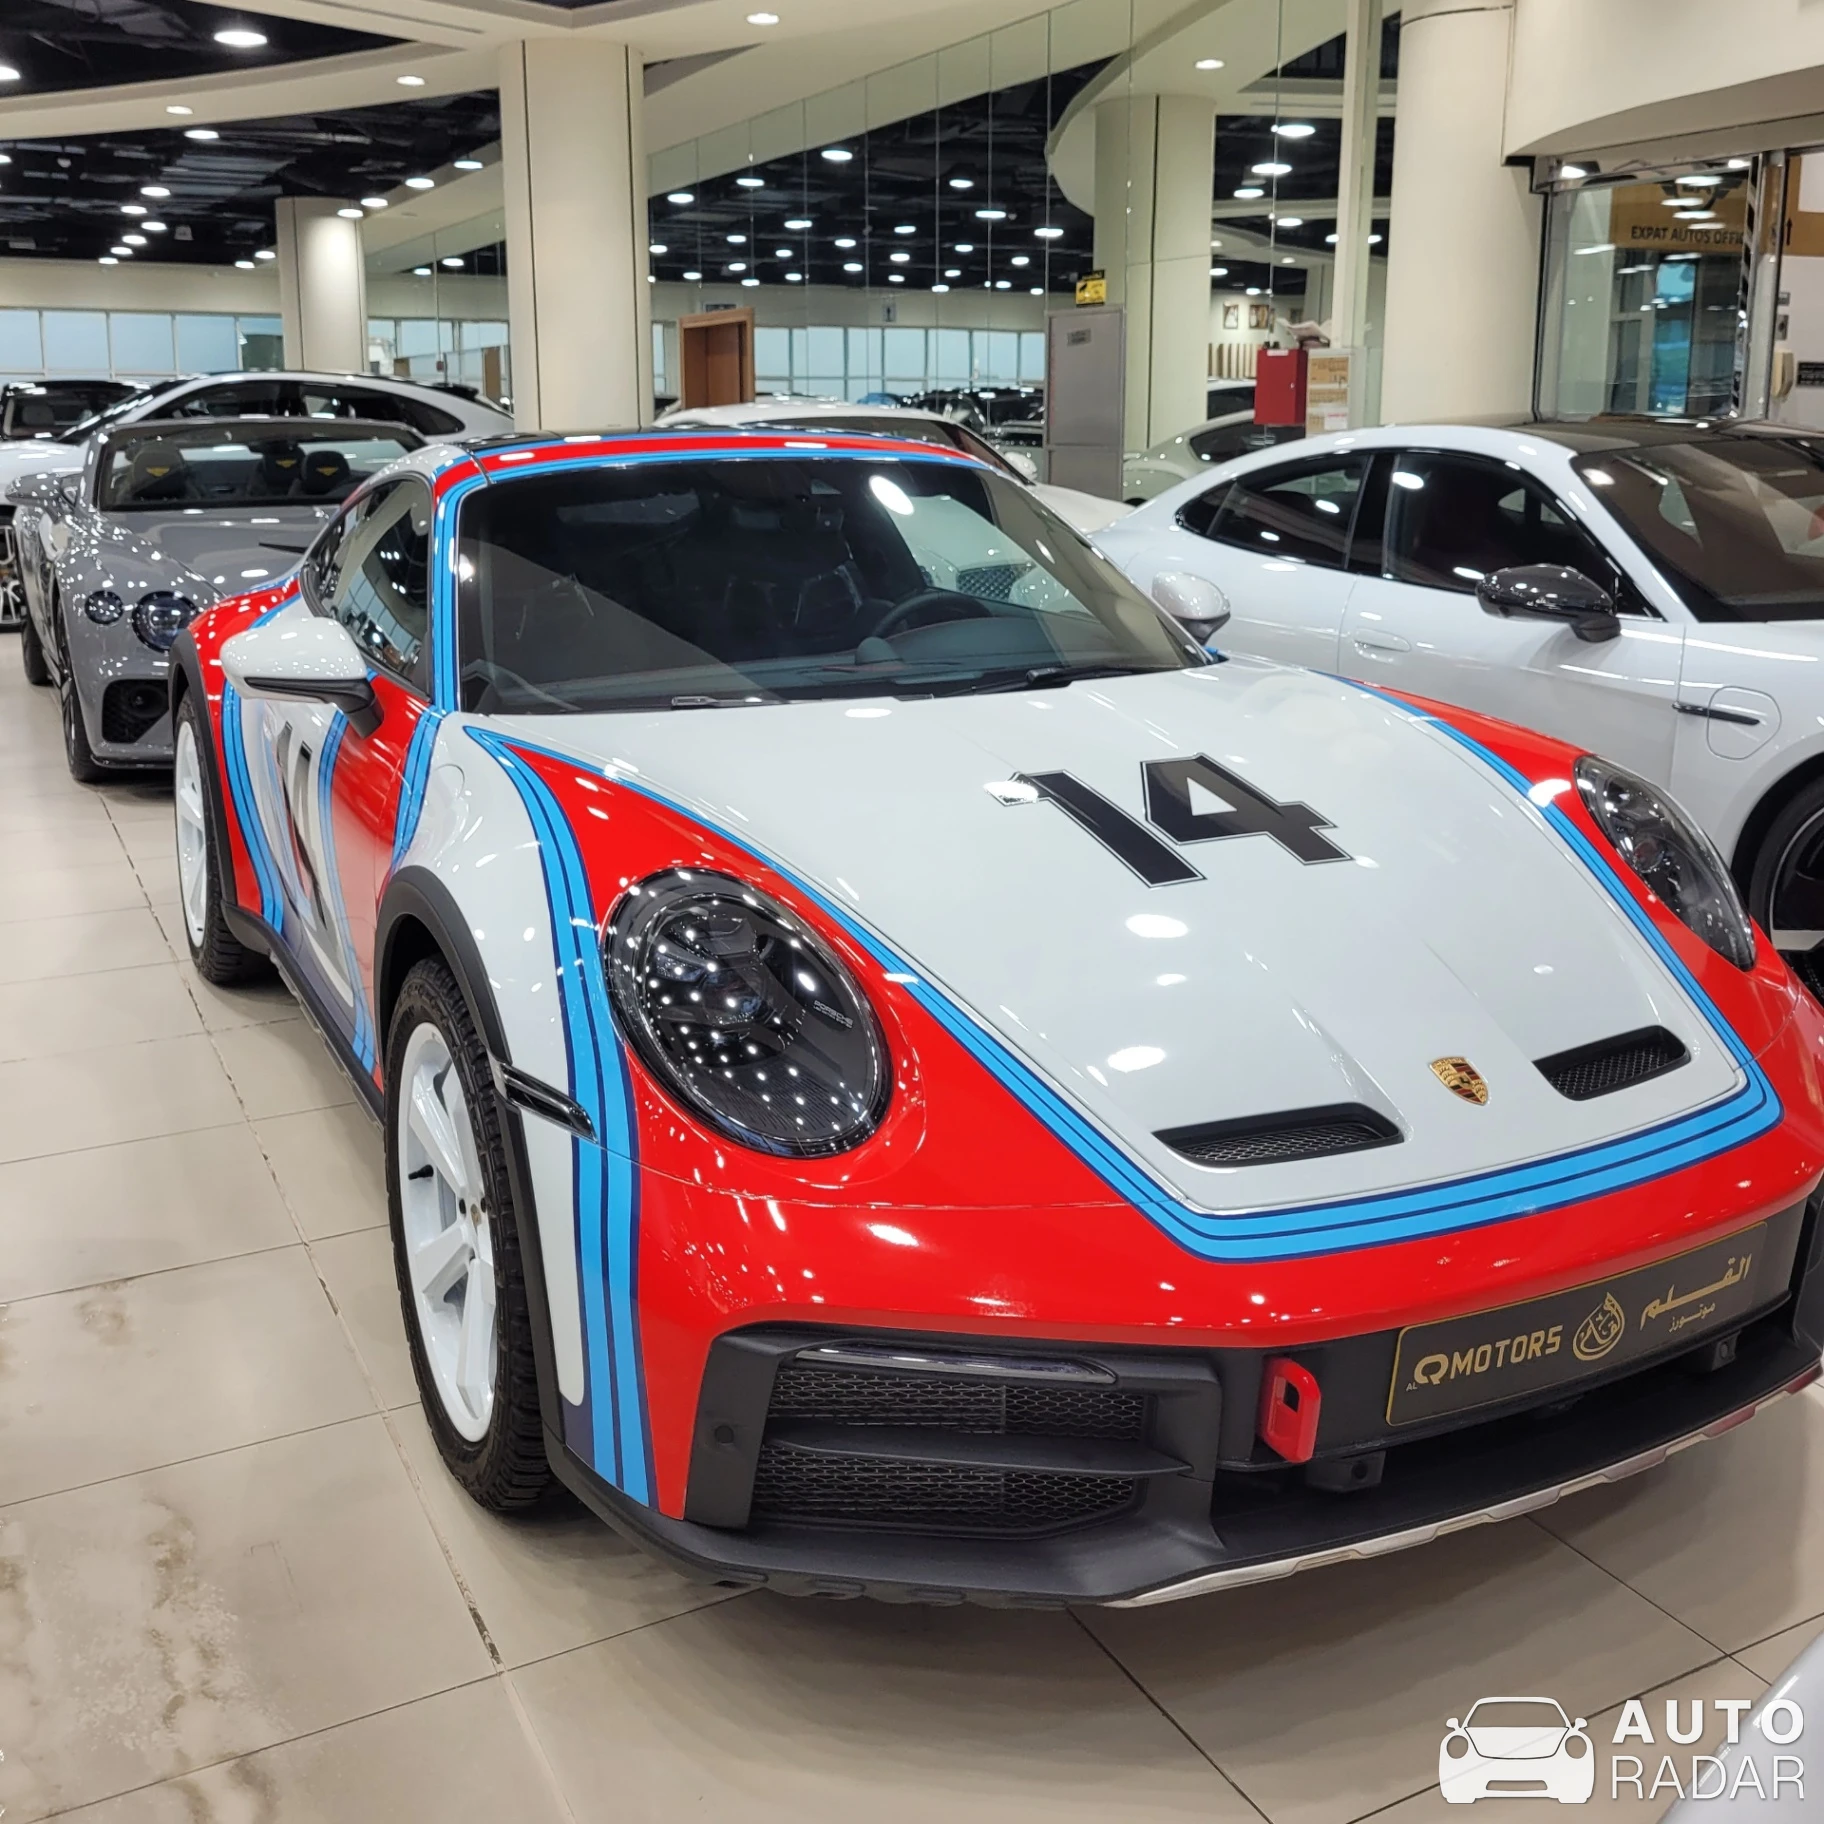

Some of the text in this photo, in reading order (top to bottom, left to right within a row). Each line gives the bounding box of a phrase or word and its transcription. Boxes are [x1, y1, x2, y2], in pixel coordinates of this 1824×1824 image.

[1631, 225, 1668, 240] EXPAT
[985, 752, 1354, 888] 14
[1640, 1253, 1752, 1331] القلم
